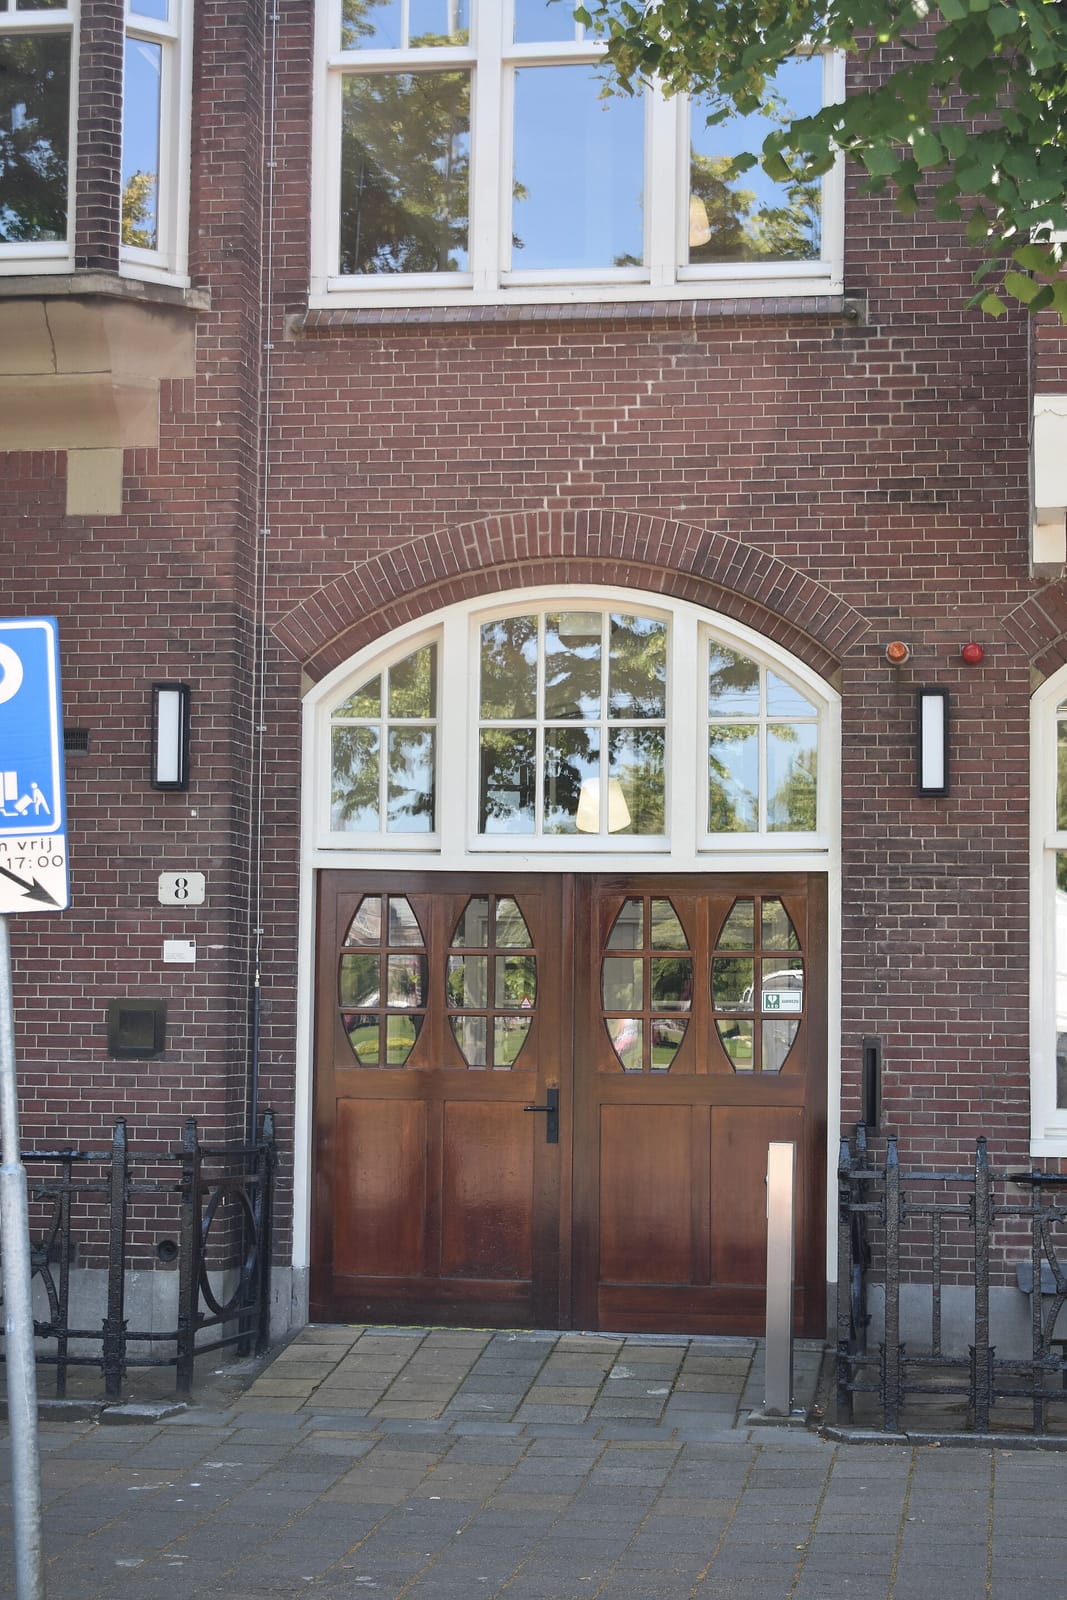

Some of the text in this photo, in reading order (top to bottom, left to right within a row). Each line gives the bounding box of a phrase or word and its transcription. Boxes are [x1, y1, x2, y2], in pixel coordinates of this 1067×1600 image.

[17, 837, 52, 853] vrij
[7, 855, 63, 870] 17:00
[174, 877, 189, 900] 8
